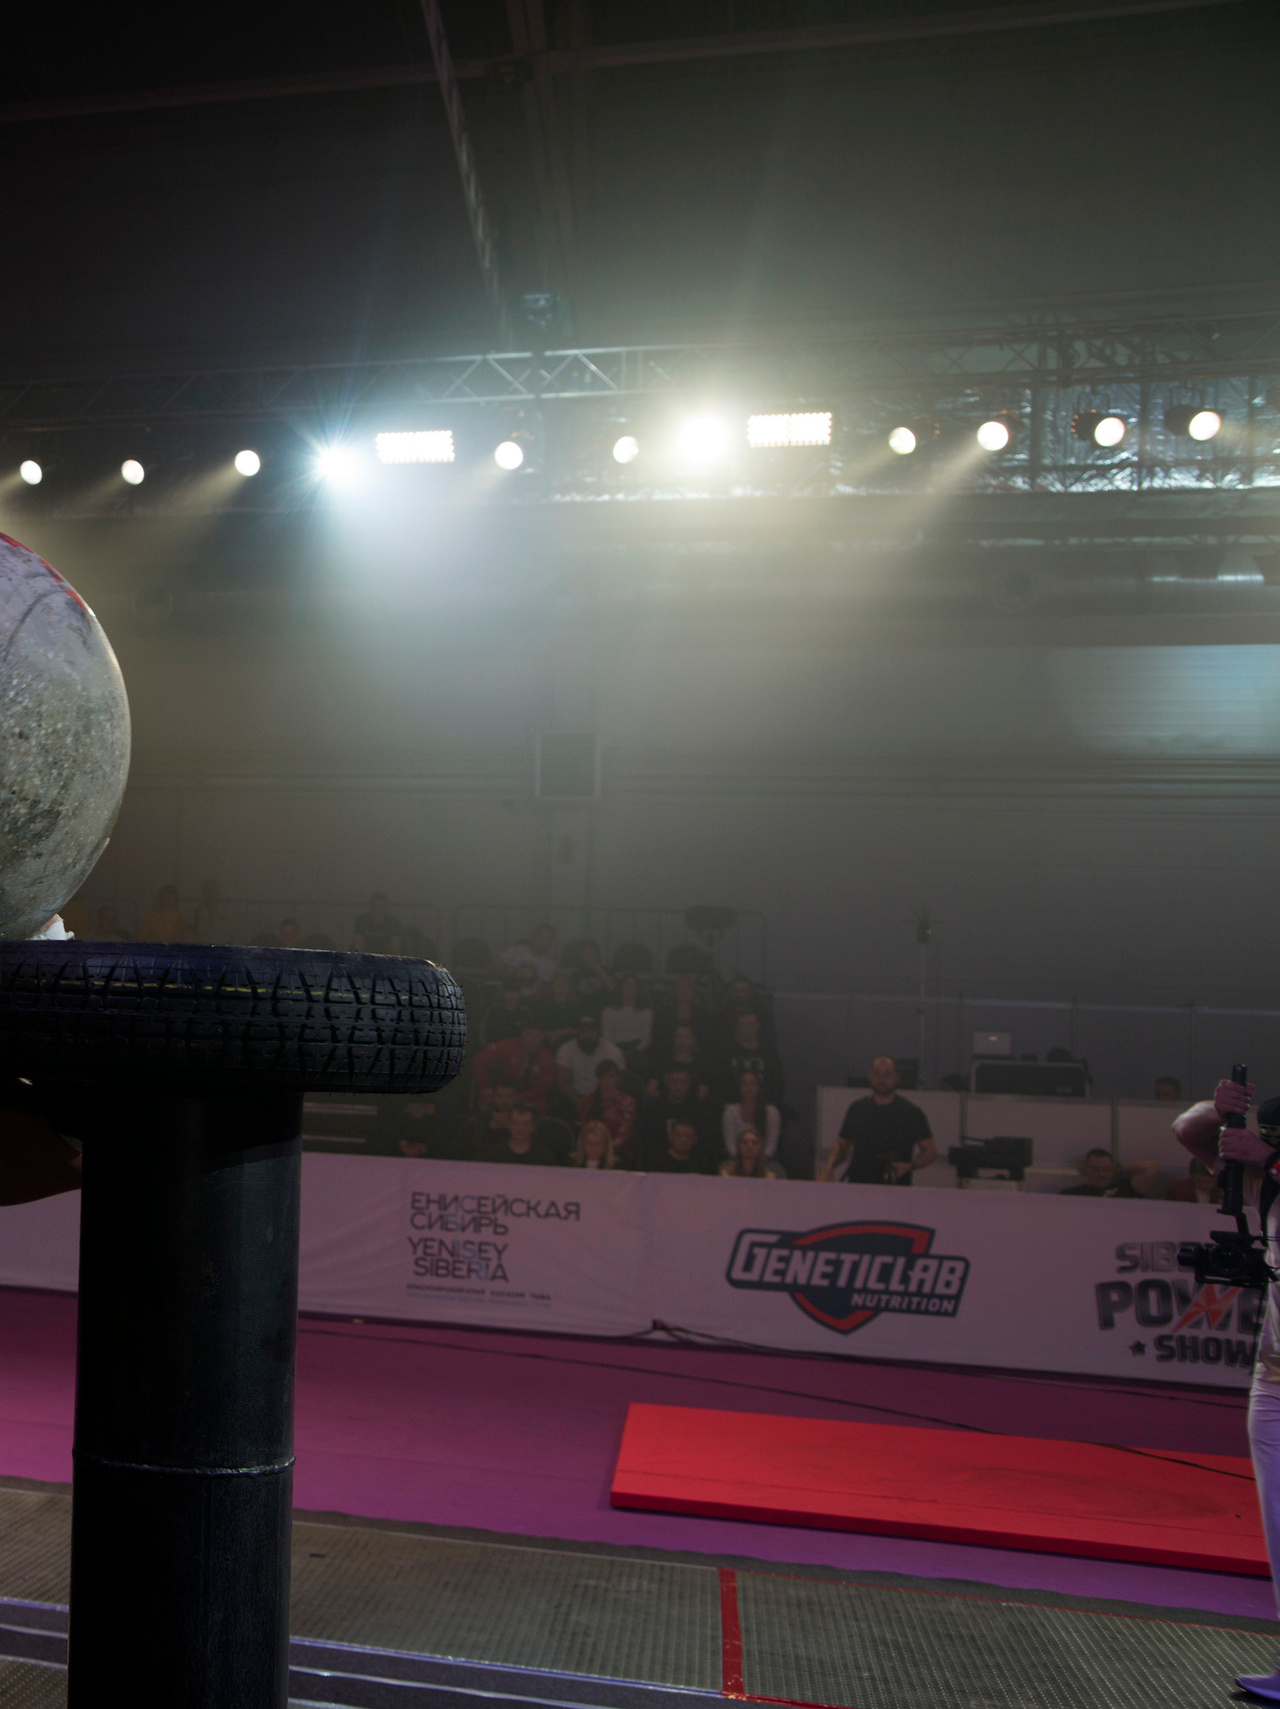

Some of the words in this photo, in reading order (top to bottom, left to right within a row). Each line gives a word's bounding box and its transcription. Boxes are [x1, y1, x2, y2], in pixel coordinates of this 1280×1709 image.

[409, 1191, 581, 1222] ЕНИСЕЙСКАЯ
[409, 1211, 510, 1236] СИБИРЬ
[407, 1235, 509, 1262] YENISEY
[413, 1256, 510, 1283] SIBERIA
[728, 1231, 965, 1297] GENETICLAB
[850, 1292, 957, 1315] NUTRITION
